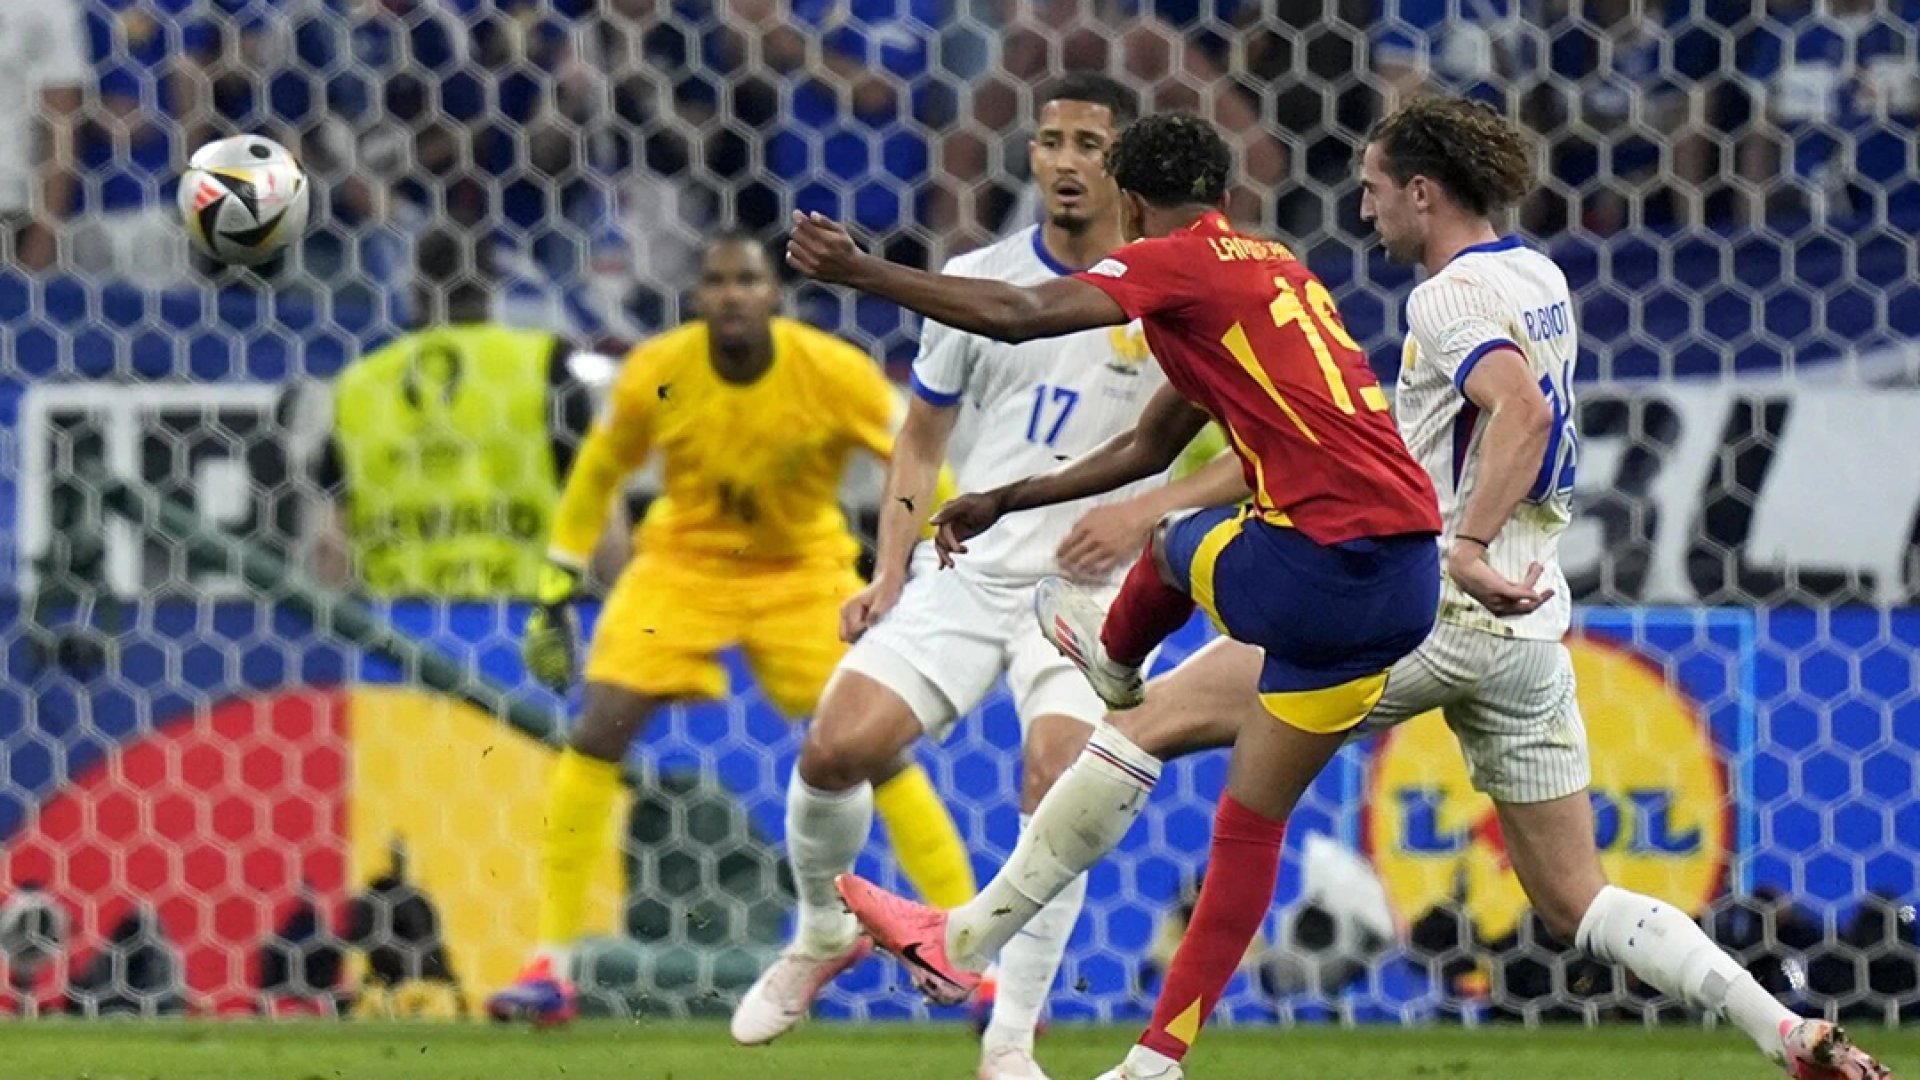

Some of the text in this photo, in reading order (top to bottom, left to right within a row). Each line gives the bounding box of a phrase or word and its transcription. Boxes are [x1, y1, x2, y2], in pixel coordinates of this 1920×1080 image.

[1524, 301, 1569, 341] RBIOT
[1026, 384, 1080, 447] 17
[1396, 788, 1702, 856] LDL
